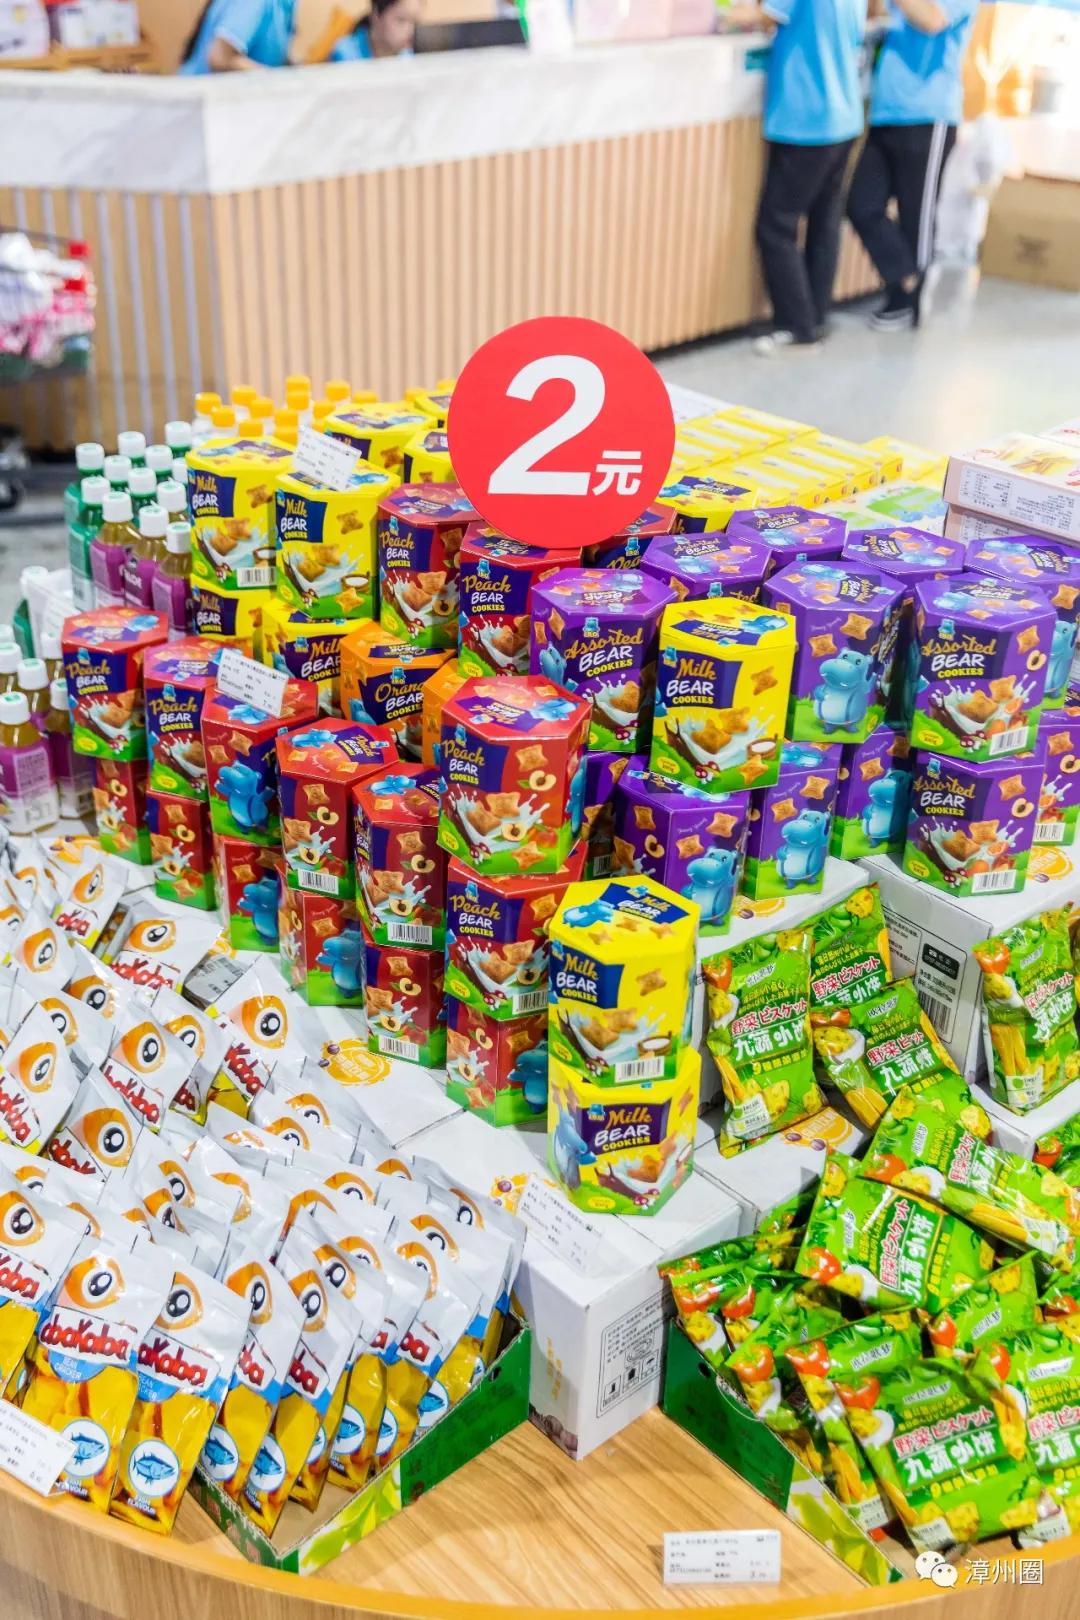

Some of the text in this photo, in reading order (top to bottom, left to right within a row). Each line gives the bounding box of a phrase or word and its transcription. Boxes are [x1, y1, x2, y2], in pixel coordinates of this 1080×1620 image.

[488, 355, 643, 496] 2元
[196, 475, 218, 494] Milk
[192, 494, 218, 508] BEAR
[285, 498, 308, 518] Milk
[280, 517, 307, 532] BEAR
[379, 530, 415, 549] Peach
[386, 547, 409, 560] BEAR
[387, 560, 411, 568] COOKIES
[462, 575, 512, 594] Peach
[471, 592, 504, 604] BEAR
[472, 604, 505, 613] COOKIES
[196, 611, 222, 626] BEAR
[564, 628, 644, 660] Assorted
[921, 633, 998, 657] Assorted
[65, 658, 112, 679] Peach
[578, 646, 634, 673] BEAR
[586, 658, 633, 678] COOKIES
[676, 658, 716, 680] Milk
[930, 650, 986, 672] BEAR
[76, 676, 106, 688] BEAR
[937, 668, 984, 680] COOKIES
[666, 679, 714, 696] BEAR
[149, 696, 198, 716] Peach
[672, 695, 714, 705] COOKIES
[158, 712, 192, 726] BEAR
[160, 722, 194, 733] COOKIES
[440, 737, 486, 766] Peach
[449, 758, 479, 776] BEAR
[450, 772, 480, 785] COOKIES
[912, 773, 976, 800] Assorted
[920, 790, 966, 810] BEAR
[925, 806, 965, 818] COOKIES
[450, 895, 501, 920] Peach
[618, 900, 662, 919] BEAR
[458, 912, 493, 930] BEAR
[459, 926, 494, 938] COOKIES
[562, 952, 600, 980] Milk
[556, 972, 598, 994] BEAR
[562, 988, 598, 1004] COOKIES
[731, 999, 808, 1036] 野菜ビスケット
[606, 1106, 652, 1130] Milk
[594, 1124, 651, 1147] BEAR
[602, 1135, 651, 1152] COOKIES
[894, 1405, 995, 1456] 野菜ビスケット
